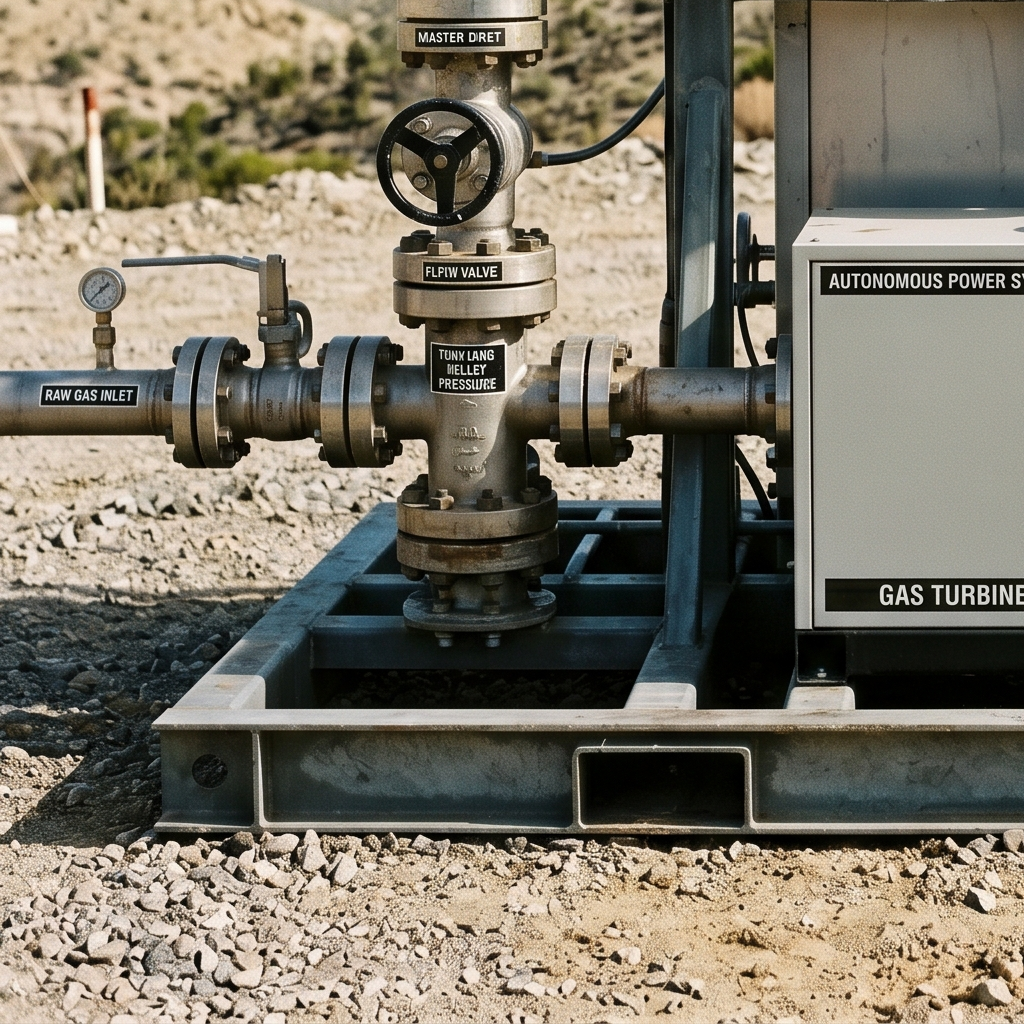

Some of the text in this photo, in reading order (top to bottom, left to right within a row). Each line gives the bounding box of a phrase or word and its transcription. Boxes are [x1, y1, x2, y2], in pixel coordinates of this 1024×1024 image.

[418, 31, 464, 44] MASTER
[460, 265, 498, 279] VALVE
[828, 272, 943, 291] AUTONOMOUS
[948, 272, 1006, 291] POWER
[467, 348, 495, 361] LANG
[44, 388, 134, 402] RAW GAS INLET
[879, 582, 924, 606] GAS
